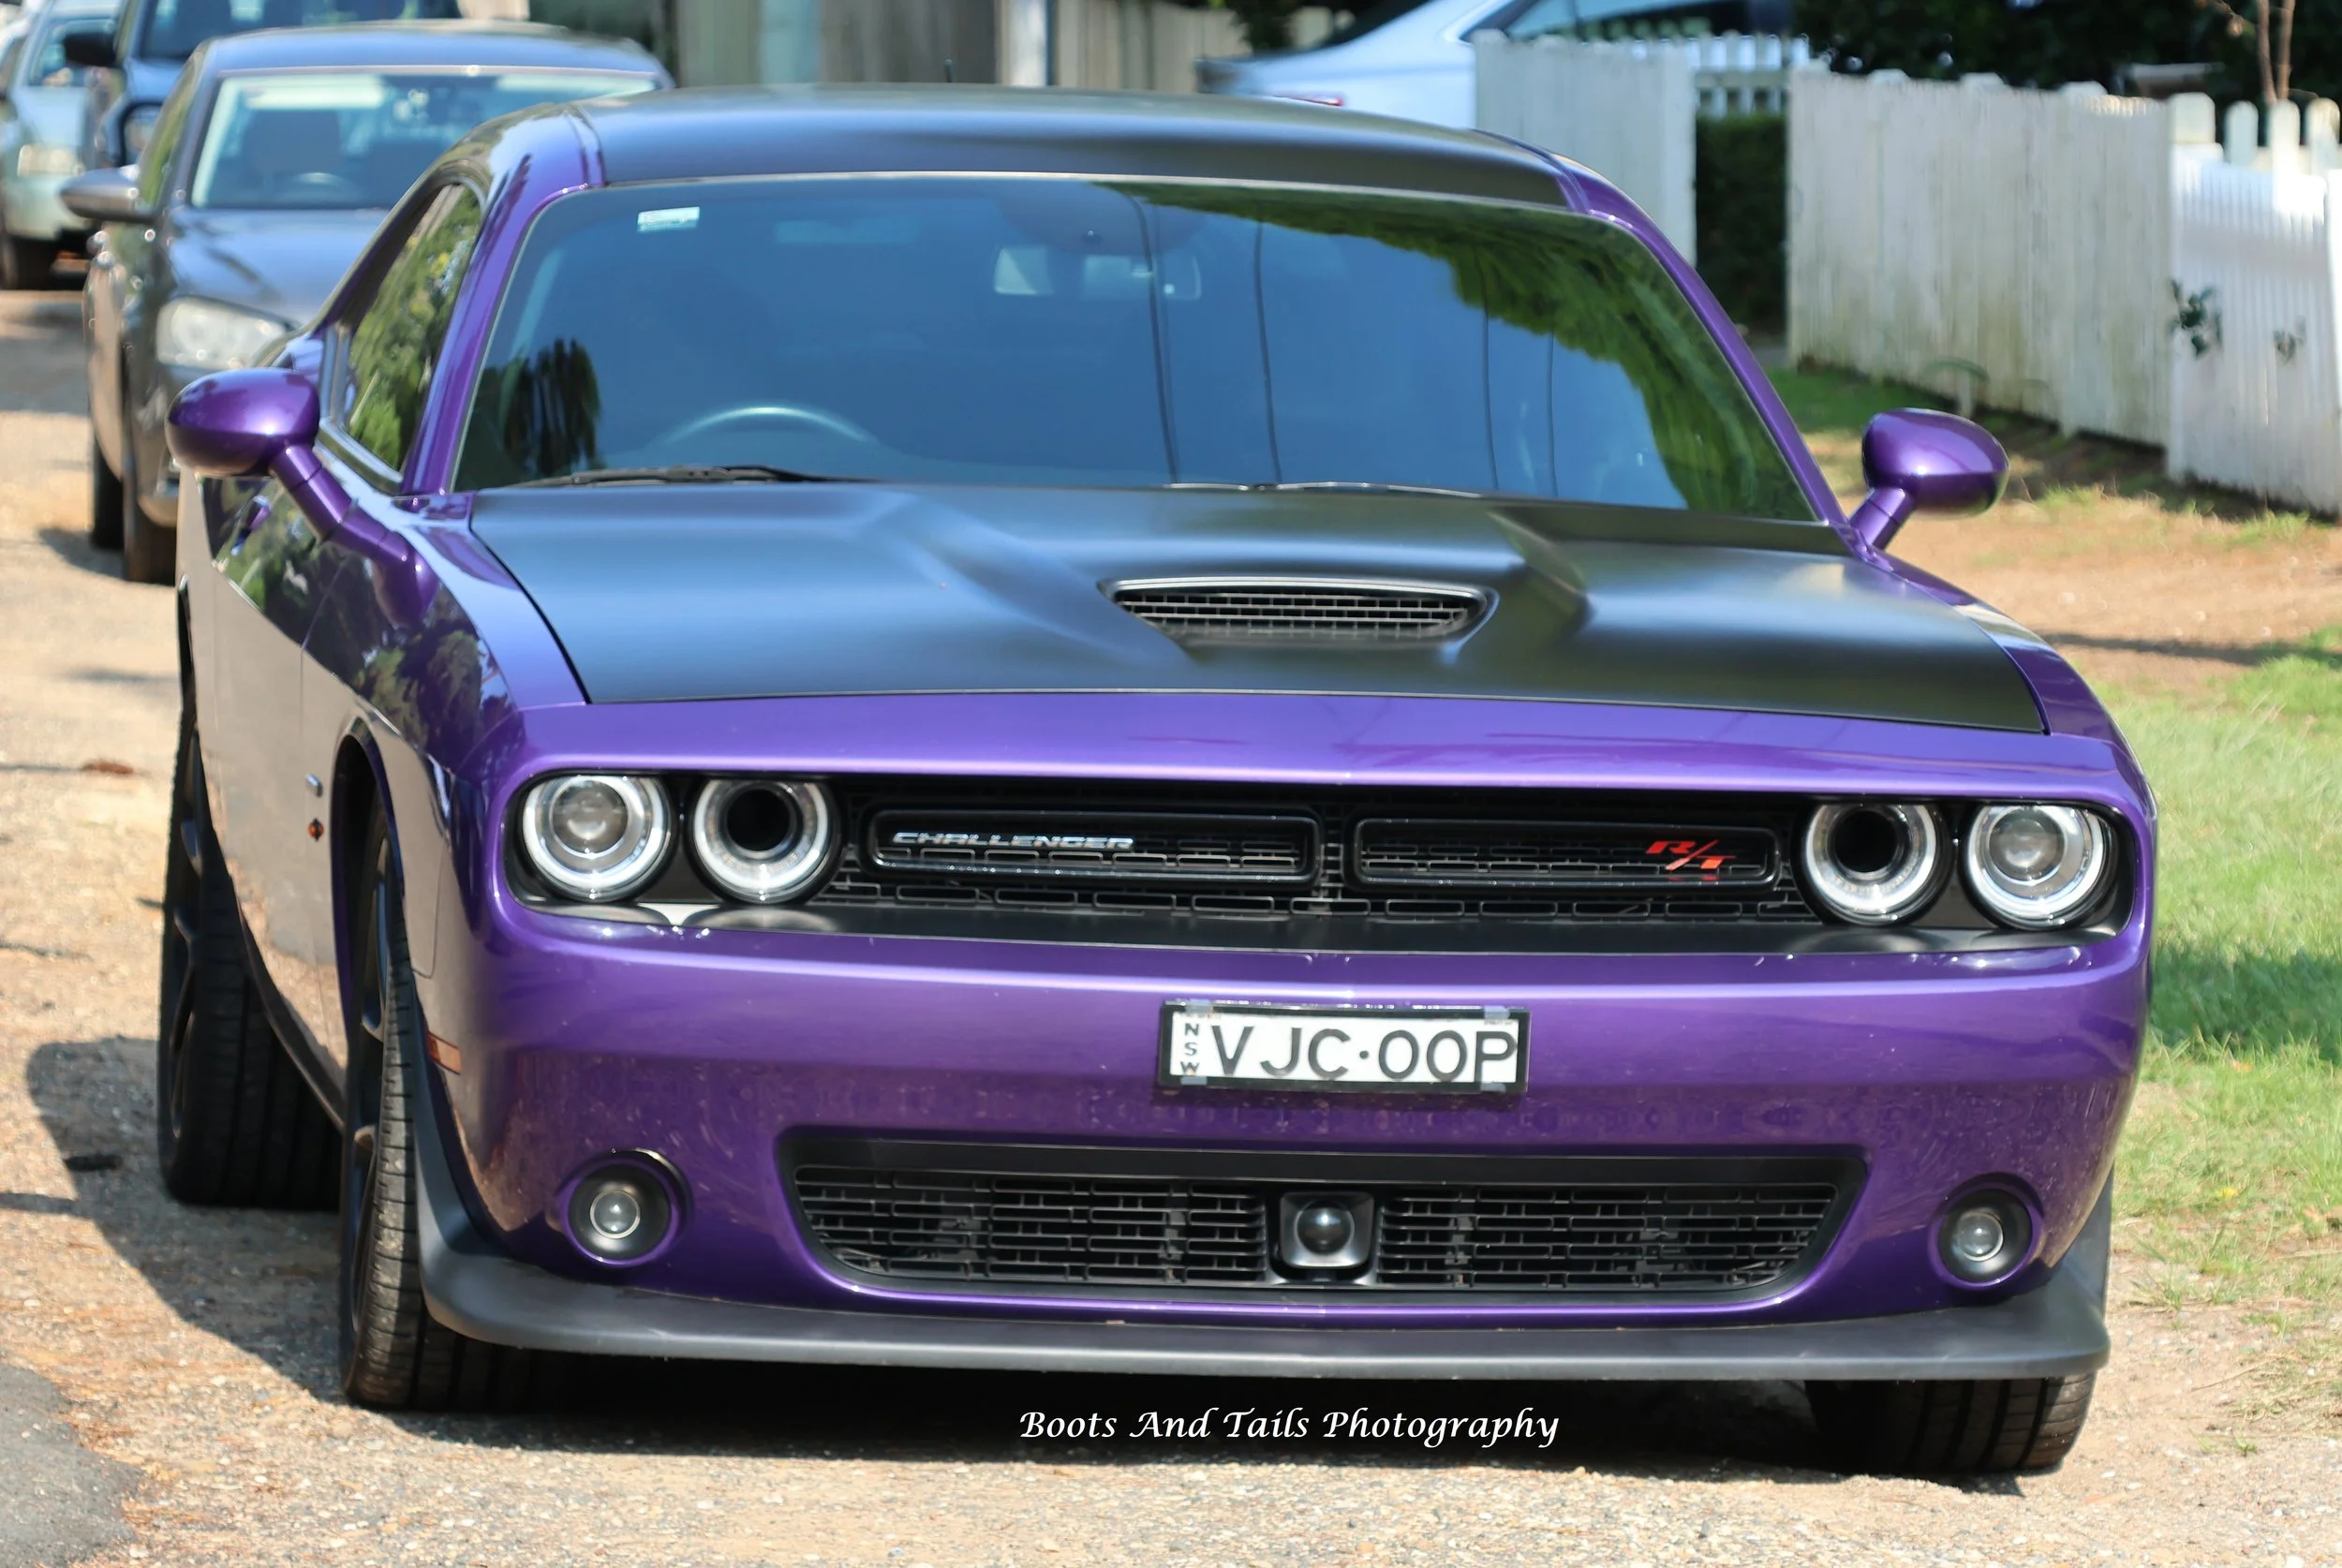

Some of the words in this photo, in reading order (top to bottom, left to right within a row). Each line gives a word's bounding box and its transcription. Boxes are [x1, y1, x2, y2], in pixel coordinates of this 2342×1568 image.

[893, 831, 1134, 850] CHALLENGER
[1645, 839, 1737, 871] R/T
[1180, 1022, 1200, 1075] NSW
